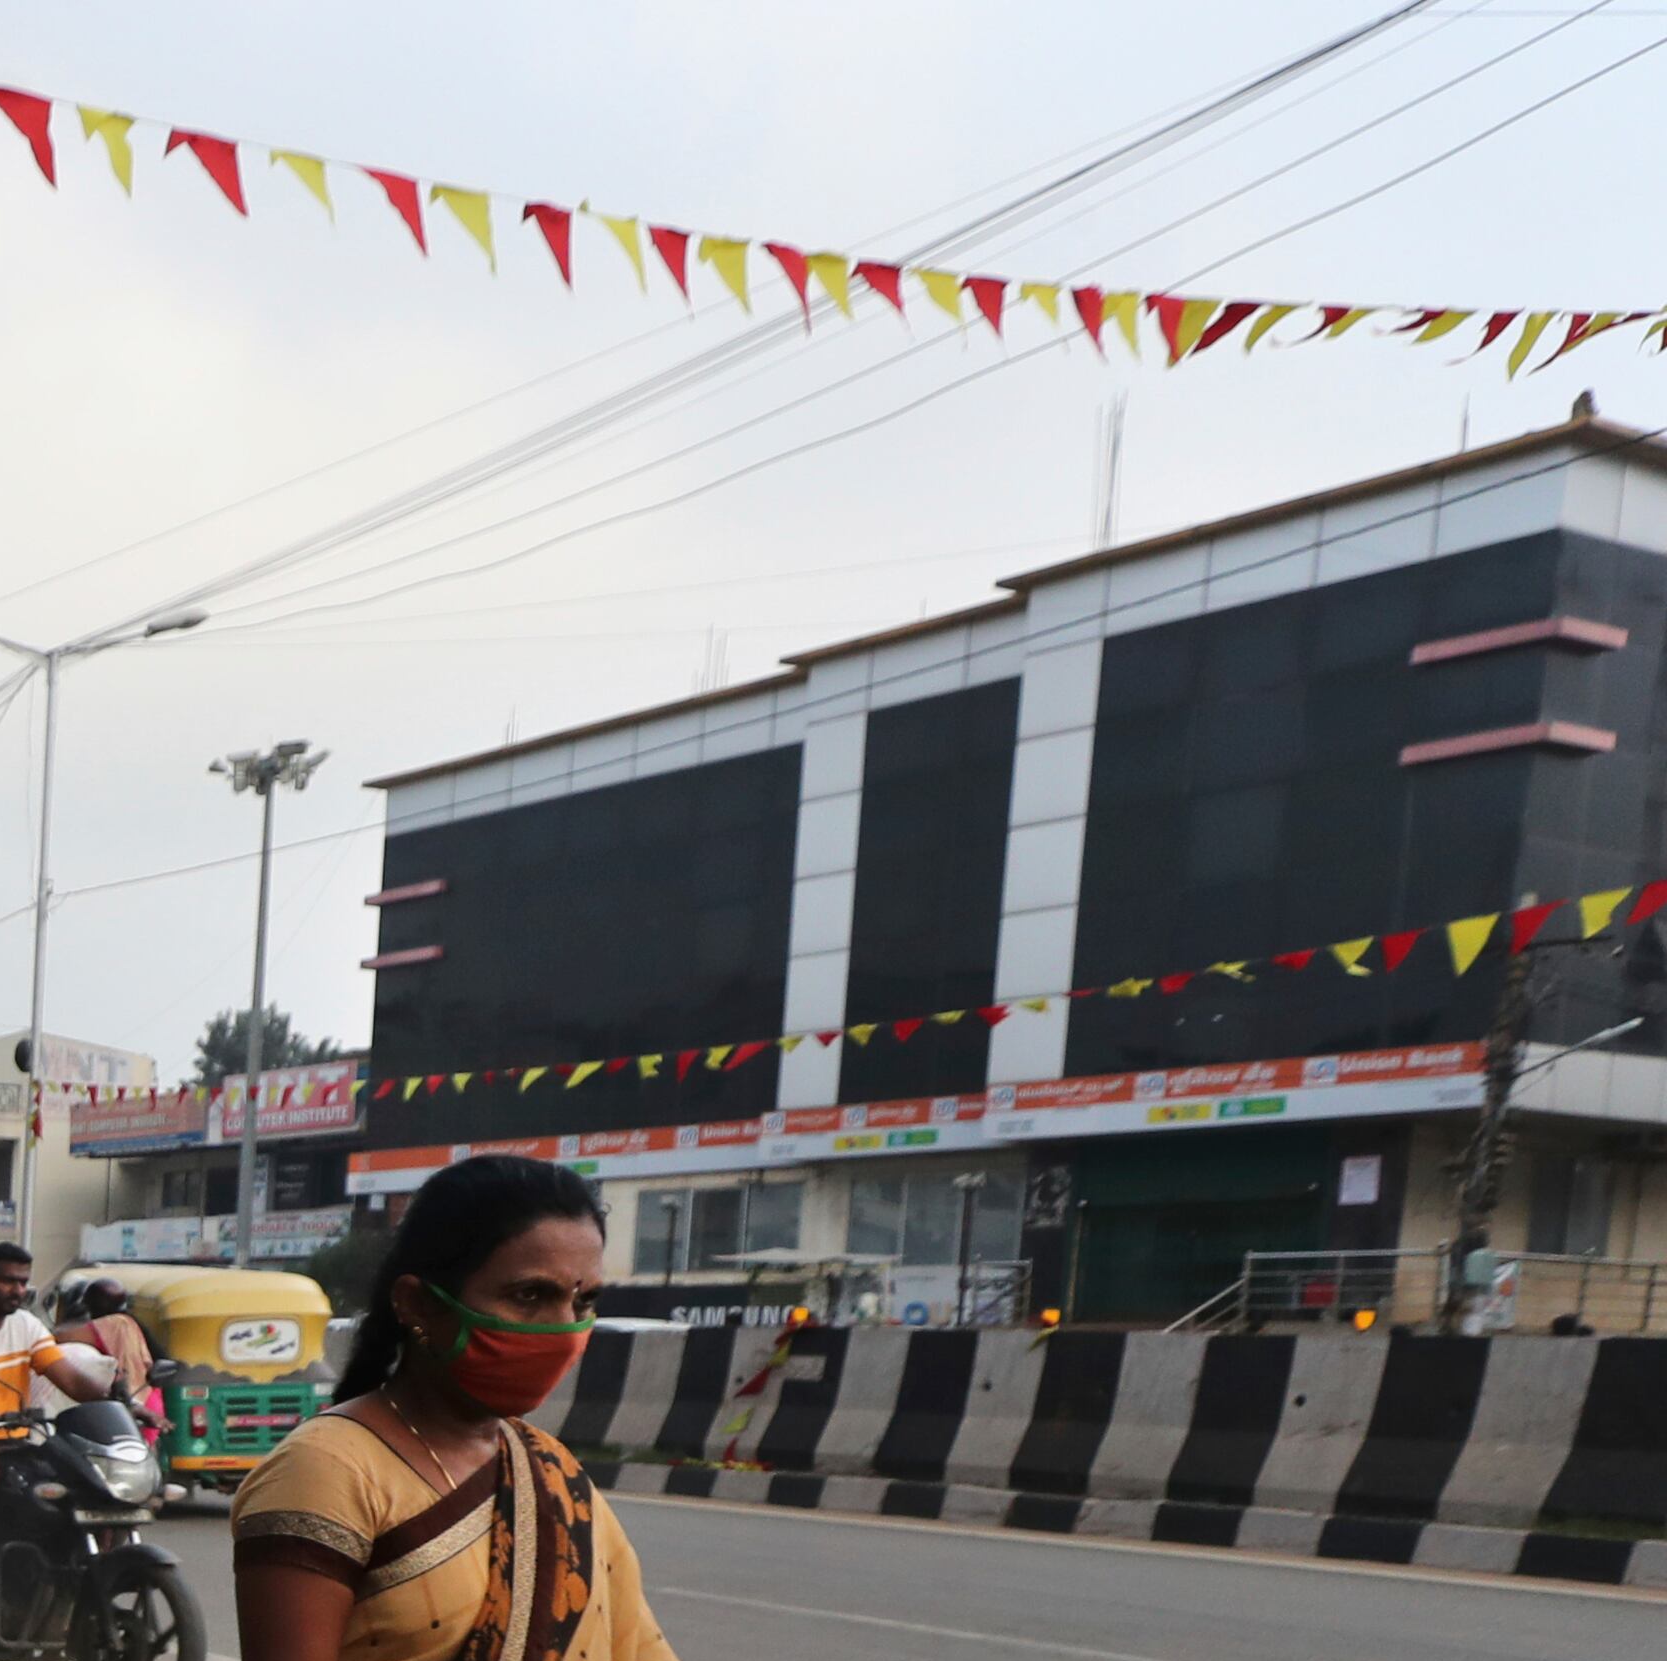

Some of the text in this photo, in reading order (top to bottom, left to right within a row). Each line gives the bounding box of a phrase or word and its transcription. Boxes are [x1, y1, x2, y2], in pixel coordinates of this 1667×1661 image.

[1338, 1047, 1463, 1074] Union Bank
[227, 1111, 284, 1130] COUTER
